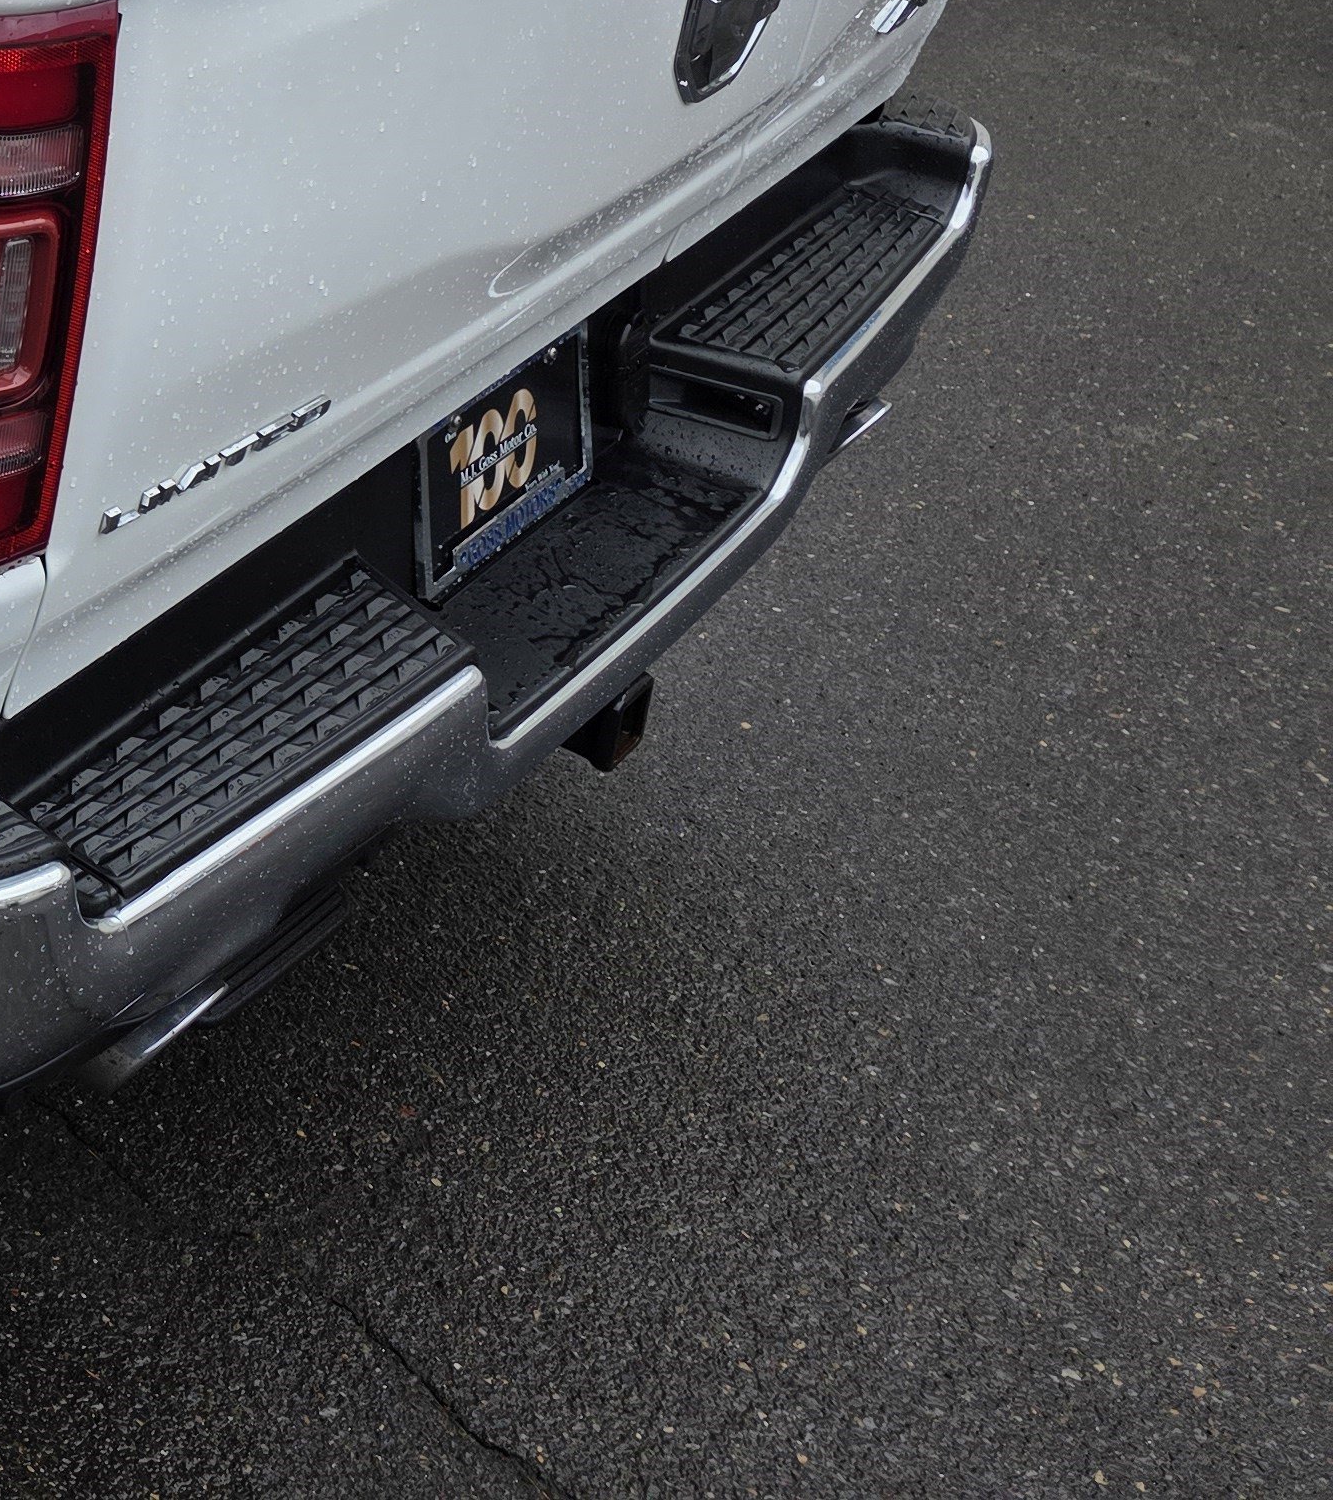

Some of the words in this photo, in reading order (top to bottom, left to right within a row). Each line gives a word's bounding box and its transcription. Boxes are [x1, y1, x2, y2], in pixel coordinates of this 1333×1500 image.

[99, 394, 331, 534] LIMITED
[449, 388, 537, 530] 100
[478, 450, 499, 471] Goss
[499, 431, 523, 458] Motor
